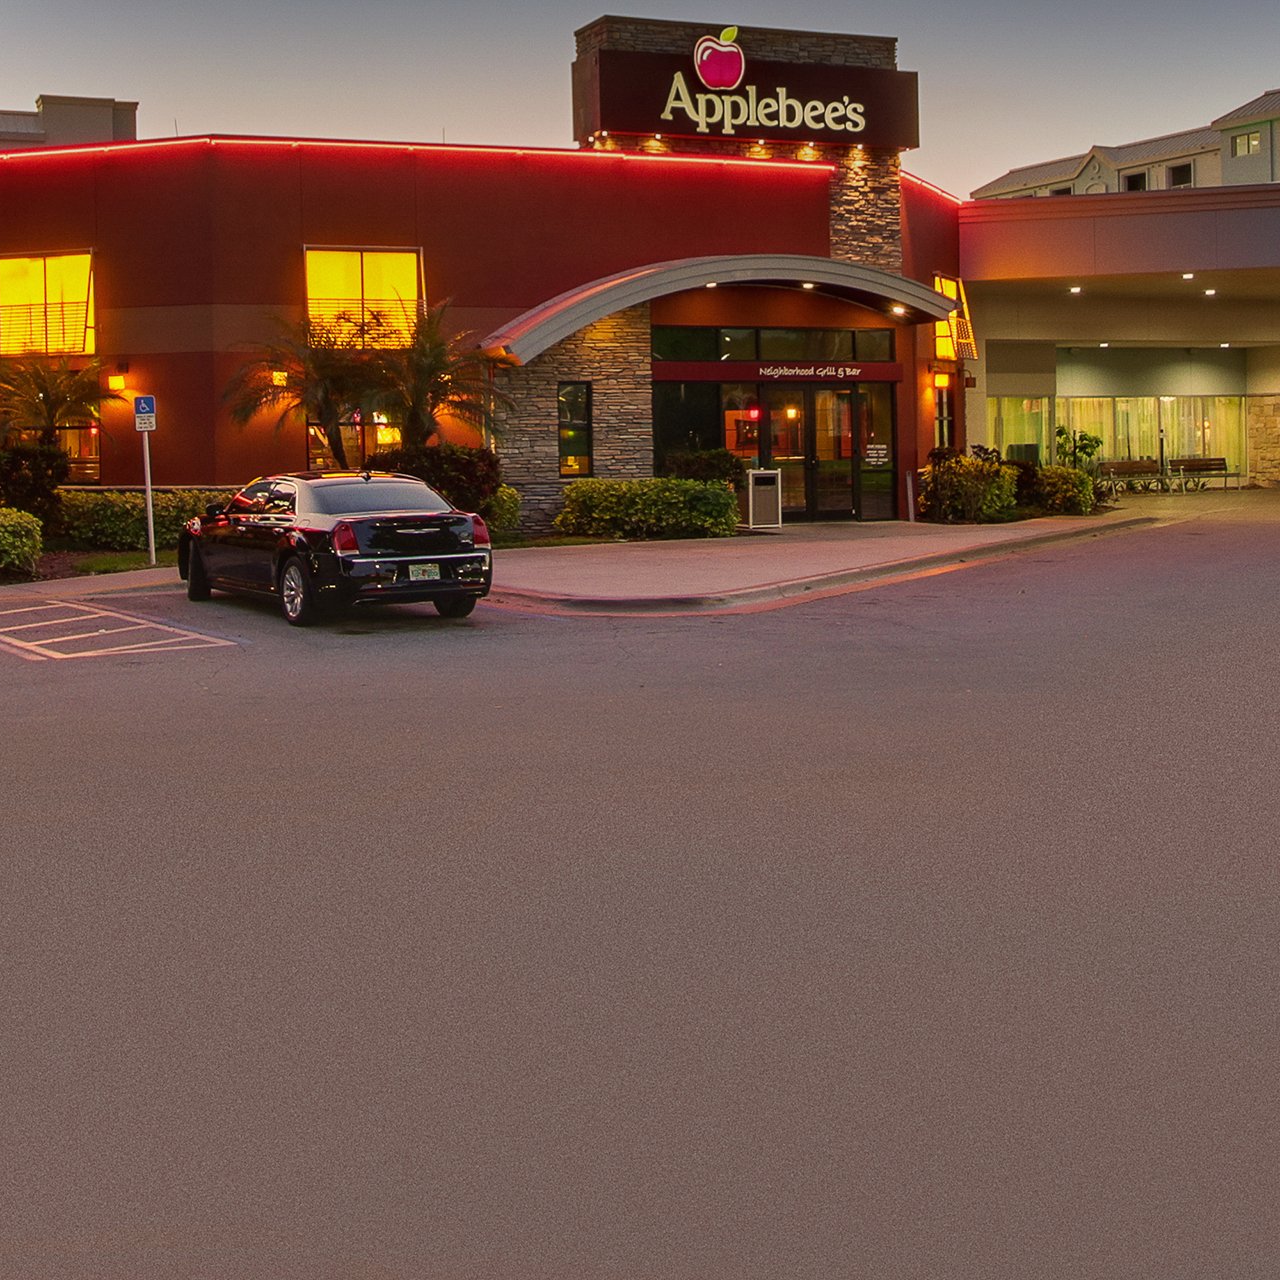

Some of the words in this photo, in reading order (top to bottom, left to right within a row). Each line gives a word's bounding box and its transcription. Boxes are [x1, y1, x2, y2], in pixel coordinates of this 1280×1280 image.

[660, 71, 866, 134] Applebee's
[759, 367, 815, 378] Neighborhood
[816, 367, 836, 377] Grill
[845, 367, 861, 376] Bar
